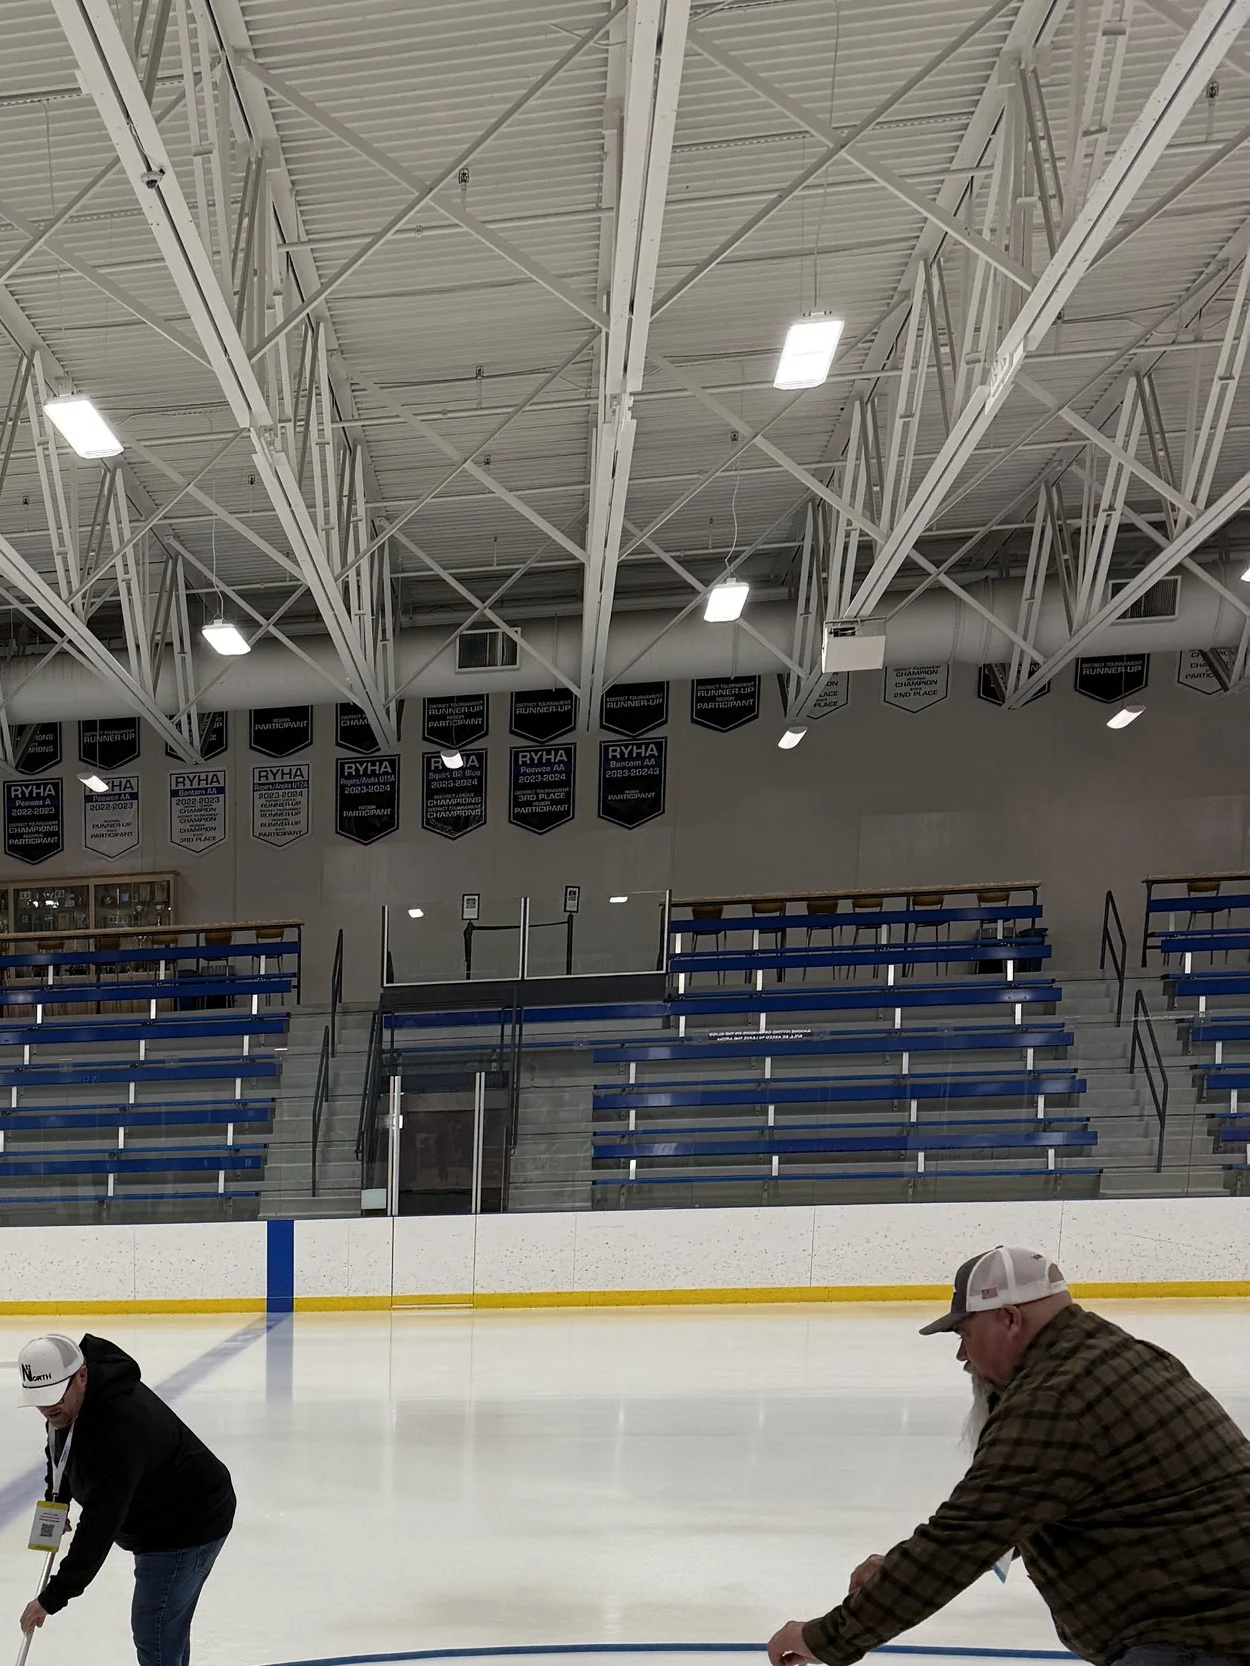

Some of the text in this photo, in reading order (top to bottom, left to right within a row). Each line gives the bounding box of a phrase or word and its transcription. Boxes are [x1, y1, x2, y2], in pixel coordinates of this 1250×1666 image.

[895, 669, 938, 677] CHAMPION
[1082, 665, 1142, 675] RUNNER-UP
[895, 680, 938, 688] CHAMPION
[697, 687, 754, 697] RUNNER-UP
[913, 689, 938, 697] PLACE
[607, 699, 662, 709] RUNNER-UP
[697, 699, 754, 710] PARTICIPANT
[429, 706, 483, 715] RUNNER-UP
[516, 705, 571, 714] RUNNER-UP
[255, 721, 308, 731] PARTICIPANT
[428, 718, 483, 728] PARTICIPANT
[84, 734, 136, 744] RUNNER-UP
[608, 744, 658, 759] RYHA
[518, 750, 568, 765] RYHA
[610, 758, 655, 768] Bantam AA
[345, 761, 392, 776] RYHA
[520, 764, 565, 774] Peewee AA
[606, 768, 659, 777] 2023-20243
[258, 767, 305, 781] RYHA
[518, 774, 566, 783] 2023-2024
[175, 774, 221, 787] RYHA
[431, 779, 478, 788] 2023-2024
[11, 784, 55, 798] RYHA
[179, 789, 205, 797] Bantam
[345, 785, 390, 794] 2023-2024
[258, 791, 303, 799] 2023-2024
[518, 793, 566, 802] 3RD PLACE
[608, 792, 655, 801] PARTICIPANT
[16, 799, 43, 807] Peewee
[176, 797, 220, 806] 2022-2023
[427, 797, 481, 807] CHAMPIONS
[12, 807, 55, 816] 2022-2023
[89, 803, 133, 811] 2022-2023
[515, 804, 568, 814] PARTICIPANT
[343, 808, 391, 817] PARTICIPANT
[427, 809, 481, 819] CHAMPIONS
[9, 825, 58, 834] CHAMPIONS
[9, 837, 58, 845] PARTICIPANT
